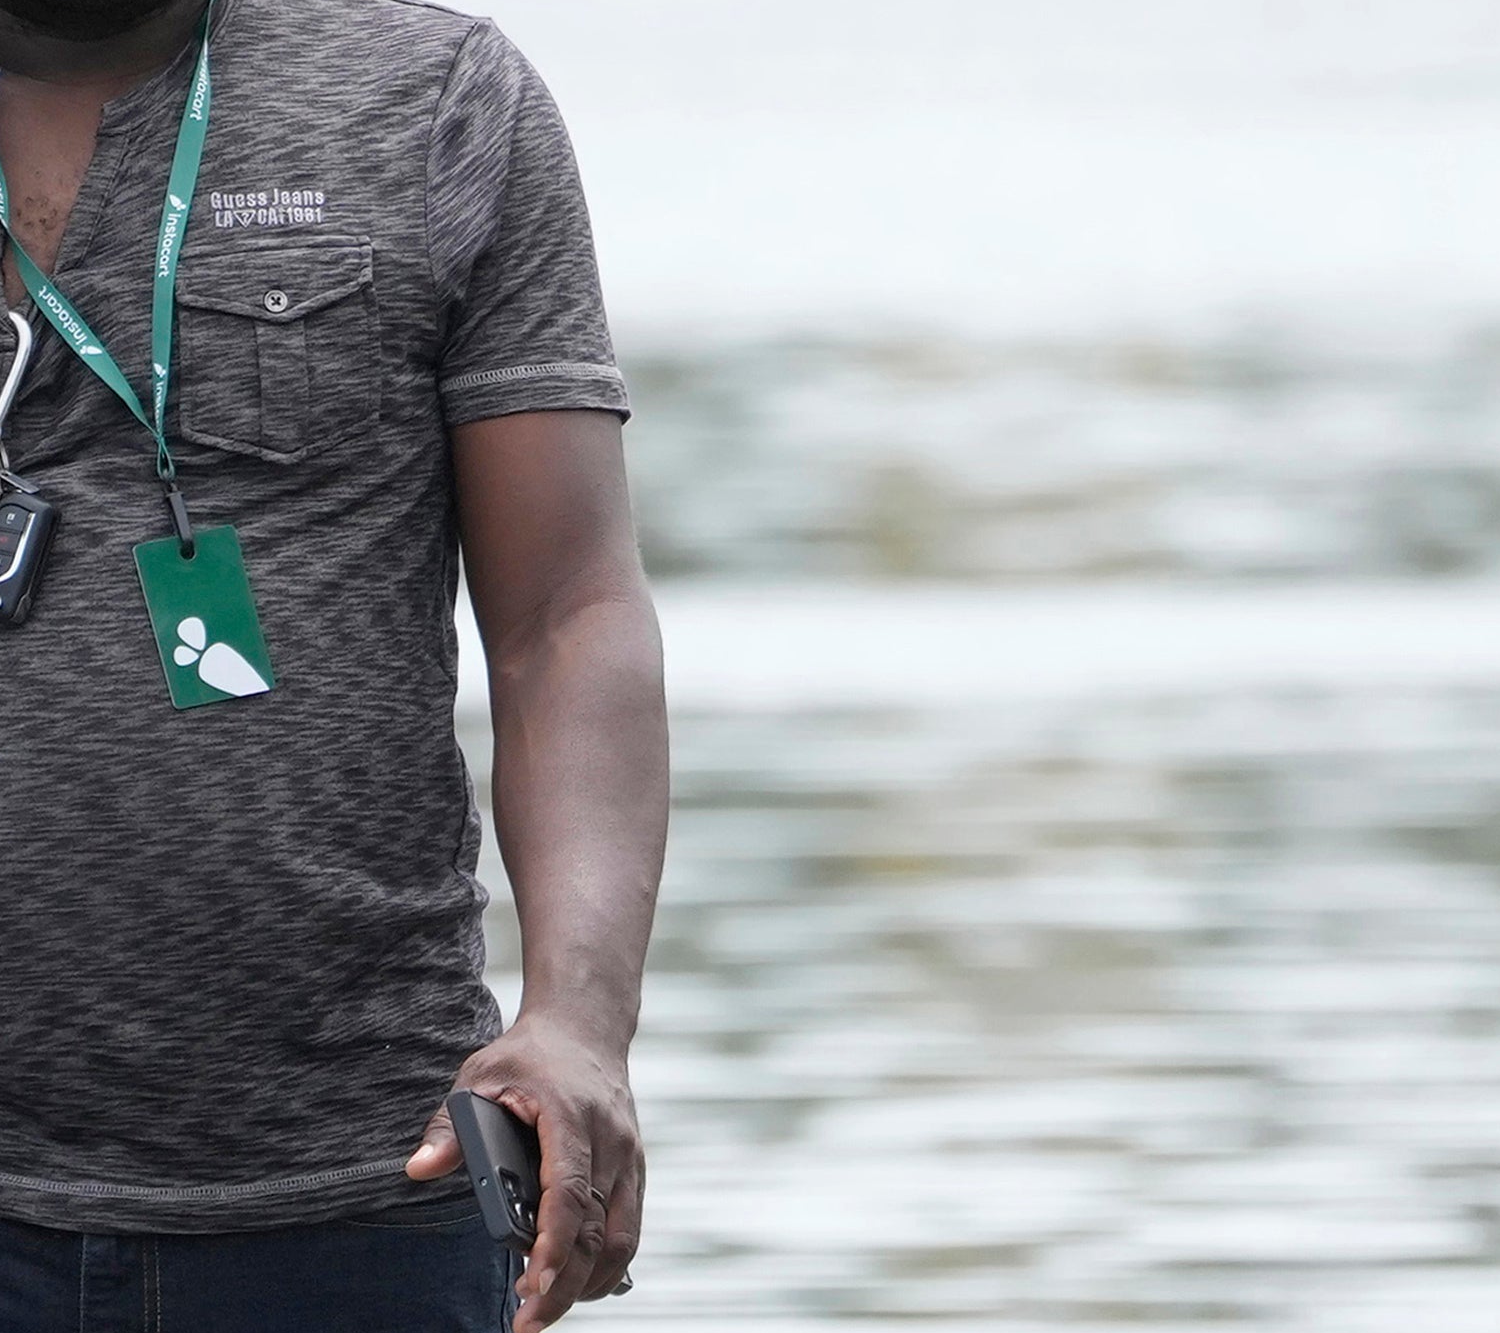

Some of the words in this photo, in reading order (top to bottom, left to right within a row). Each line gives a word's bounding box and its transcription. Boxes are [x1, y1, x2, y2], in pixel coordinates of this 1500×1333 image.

[210, 191, 268, 209] Guess
[272, 188, 325, 206] Jeans
[215, 210, 234, 227] LA
[158, 213, 182, 278] Instacart
[38, 285, 88, 345] Instacart
